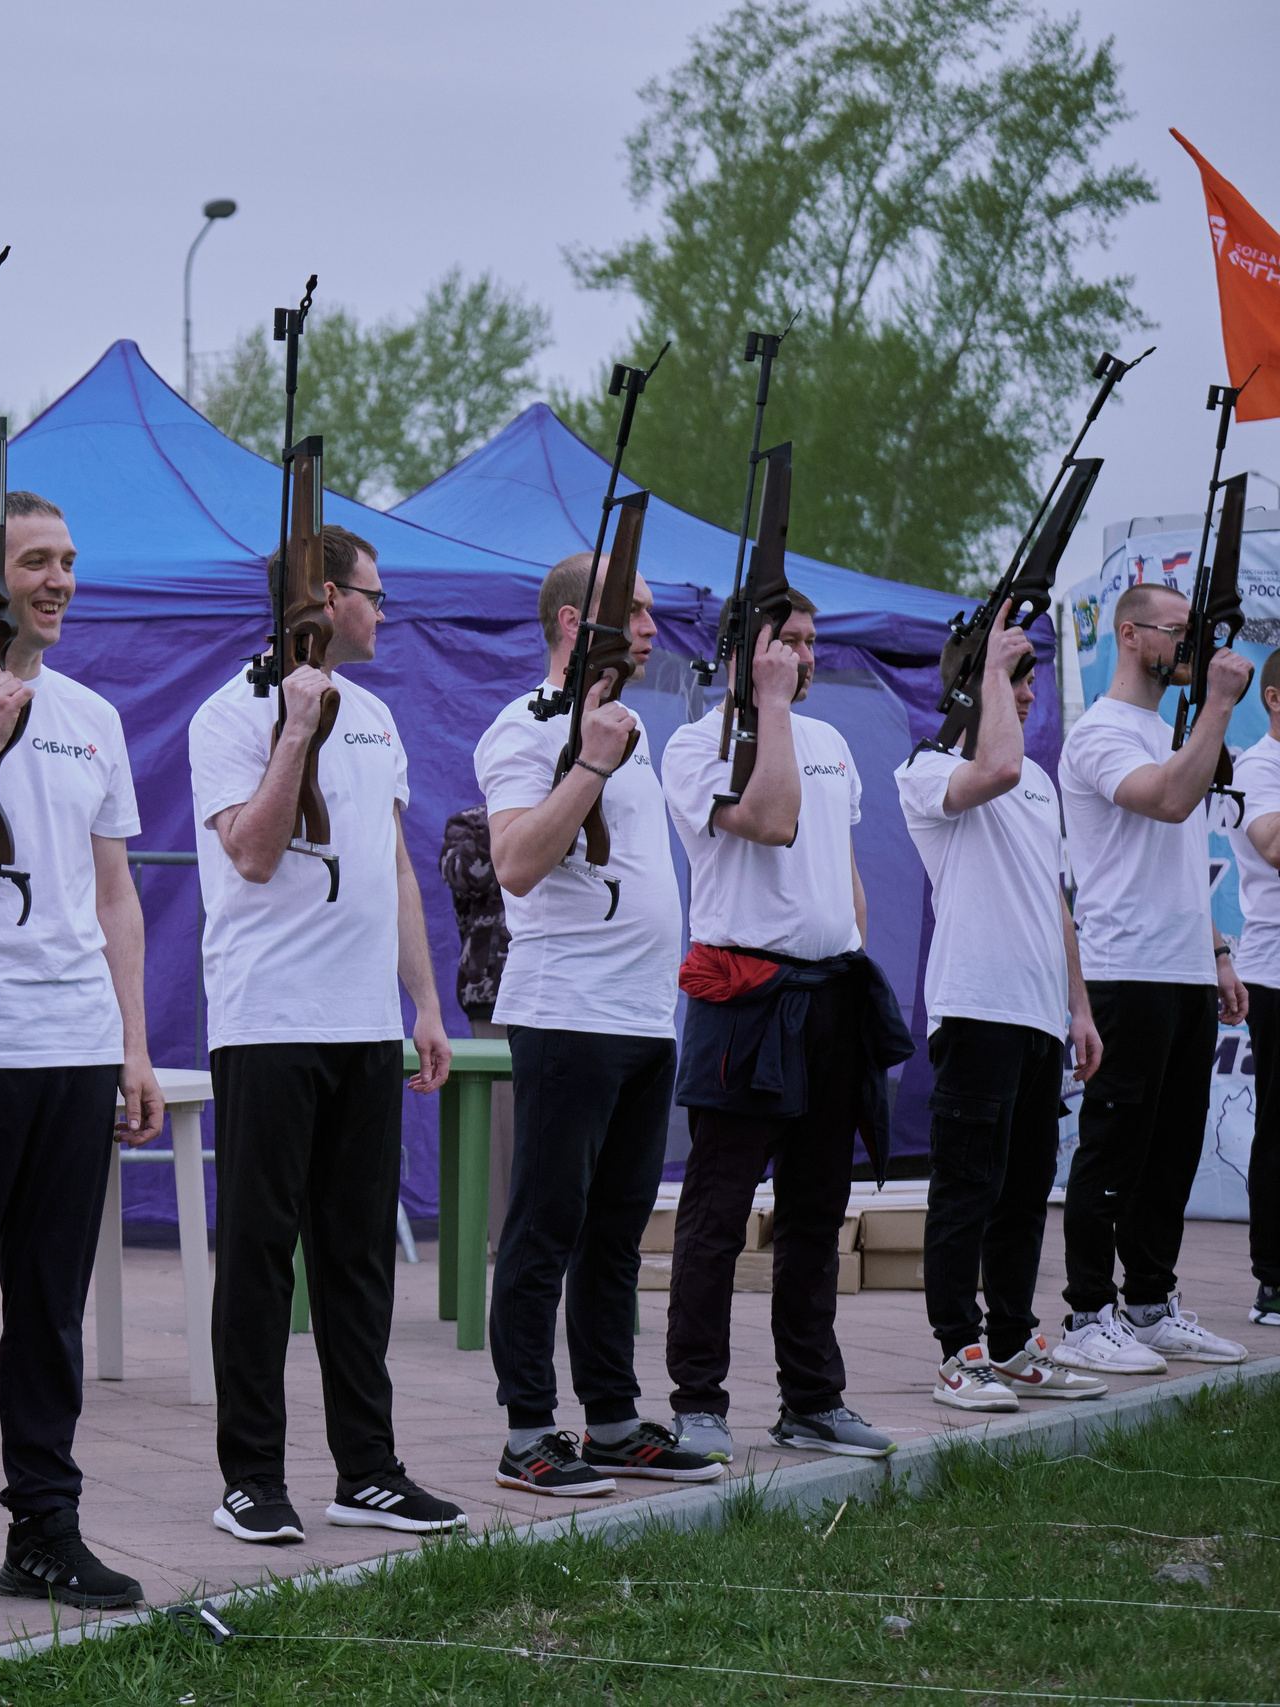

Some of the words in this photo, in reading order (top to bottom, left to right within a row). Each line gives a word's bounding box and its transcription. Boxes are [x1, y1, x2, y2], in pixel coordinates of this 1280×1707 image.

[1235, 243, 1280, 266] БОГДА
[32, 737, 93, 761] СИБАГРО
[343, 732, 391, 747] СИБАГРО
